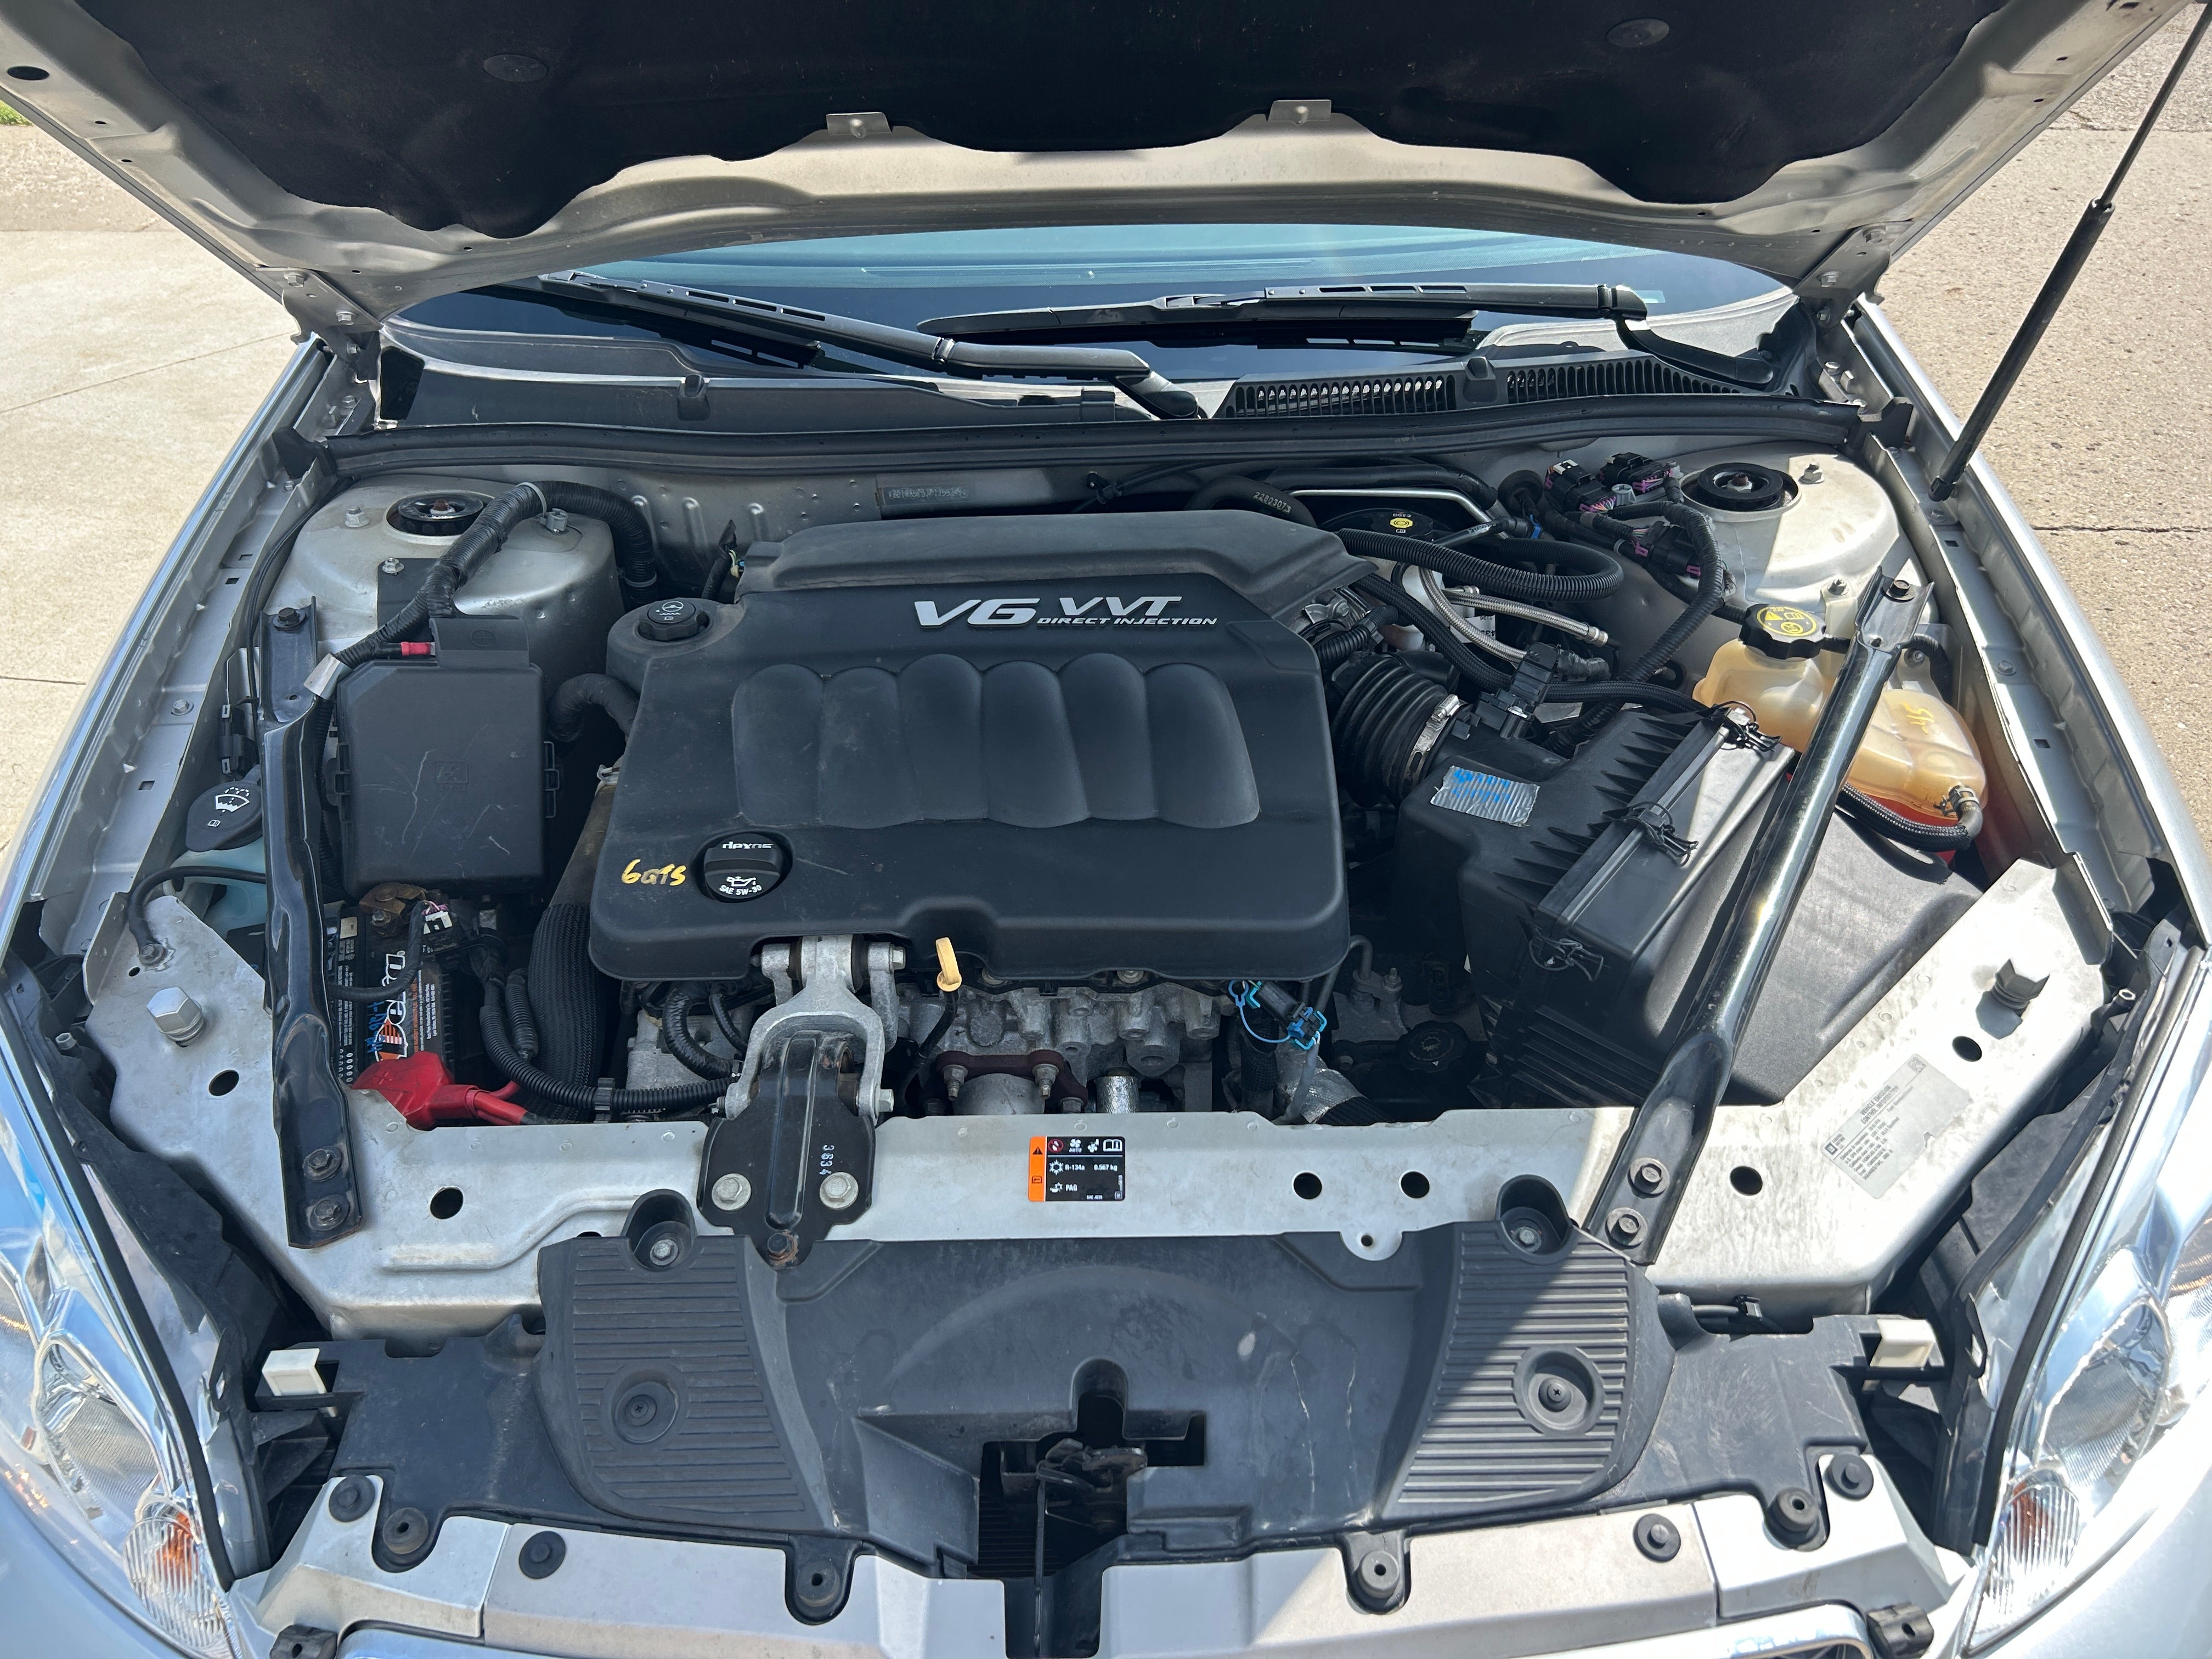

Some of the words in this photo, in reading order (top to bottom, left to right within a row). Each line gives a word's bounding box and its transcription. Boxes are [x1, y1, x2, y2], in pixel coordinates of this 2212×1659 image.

[914, 598, 1040, 626] V6
[1059, 596, 1182, 616] VVT
[719, 884, 733, 895] SAE
[736, 884, 762, 895] 5W-30
[1110, 1164, 1118, 1172] kg
